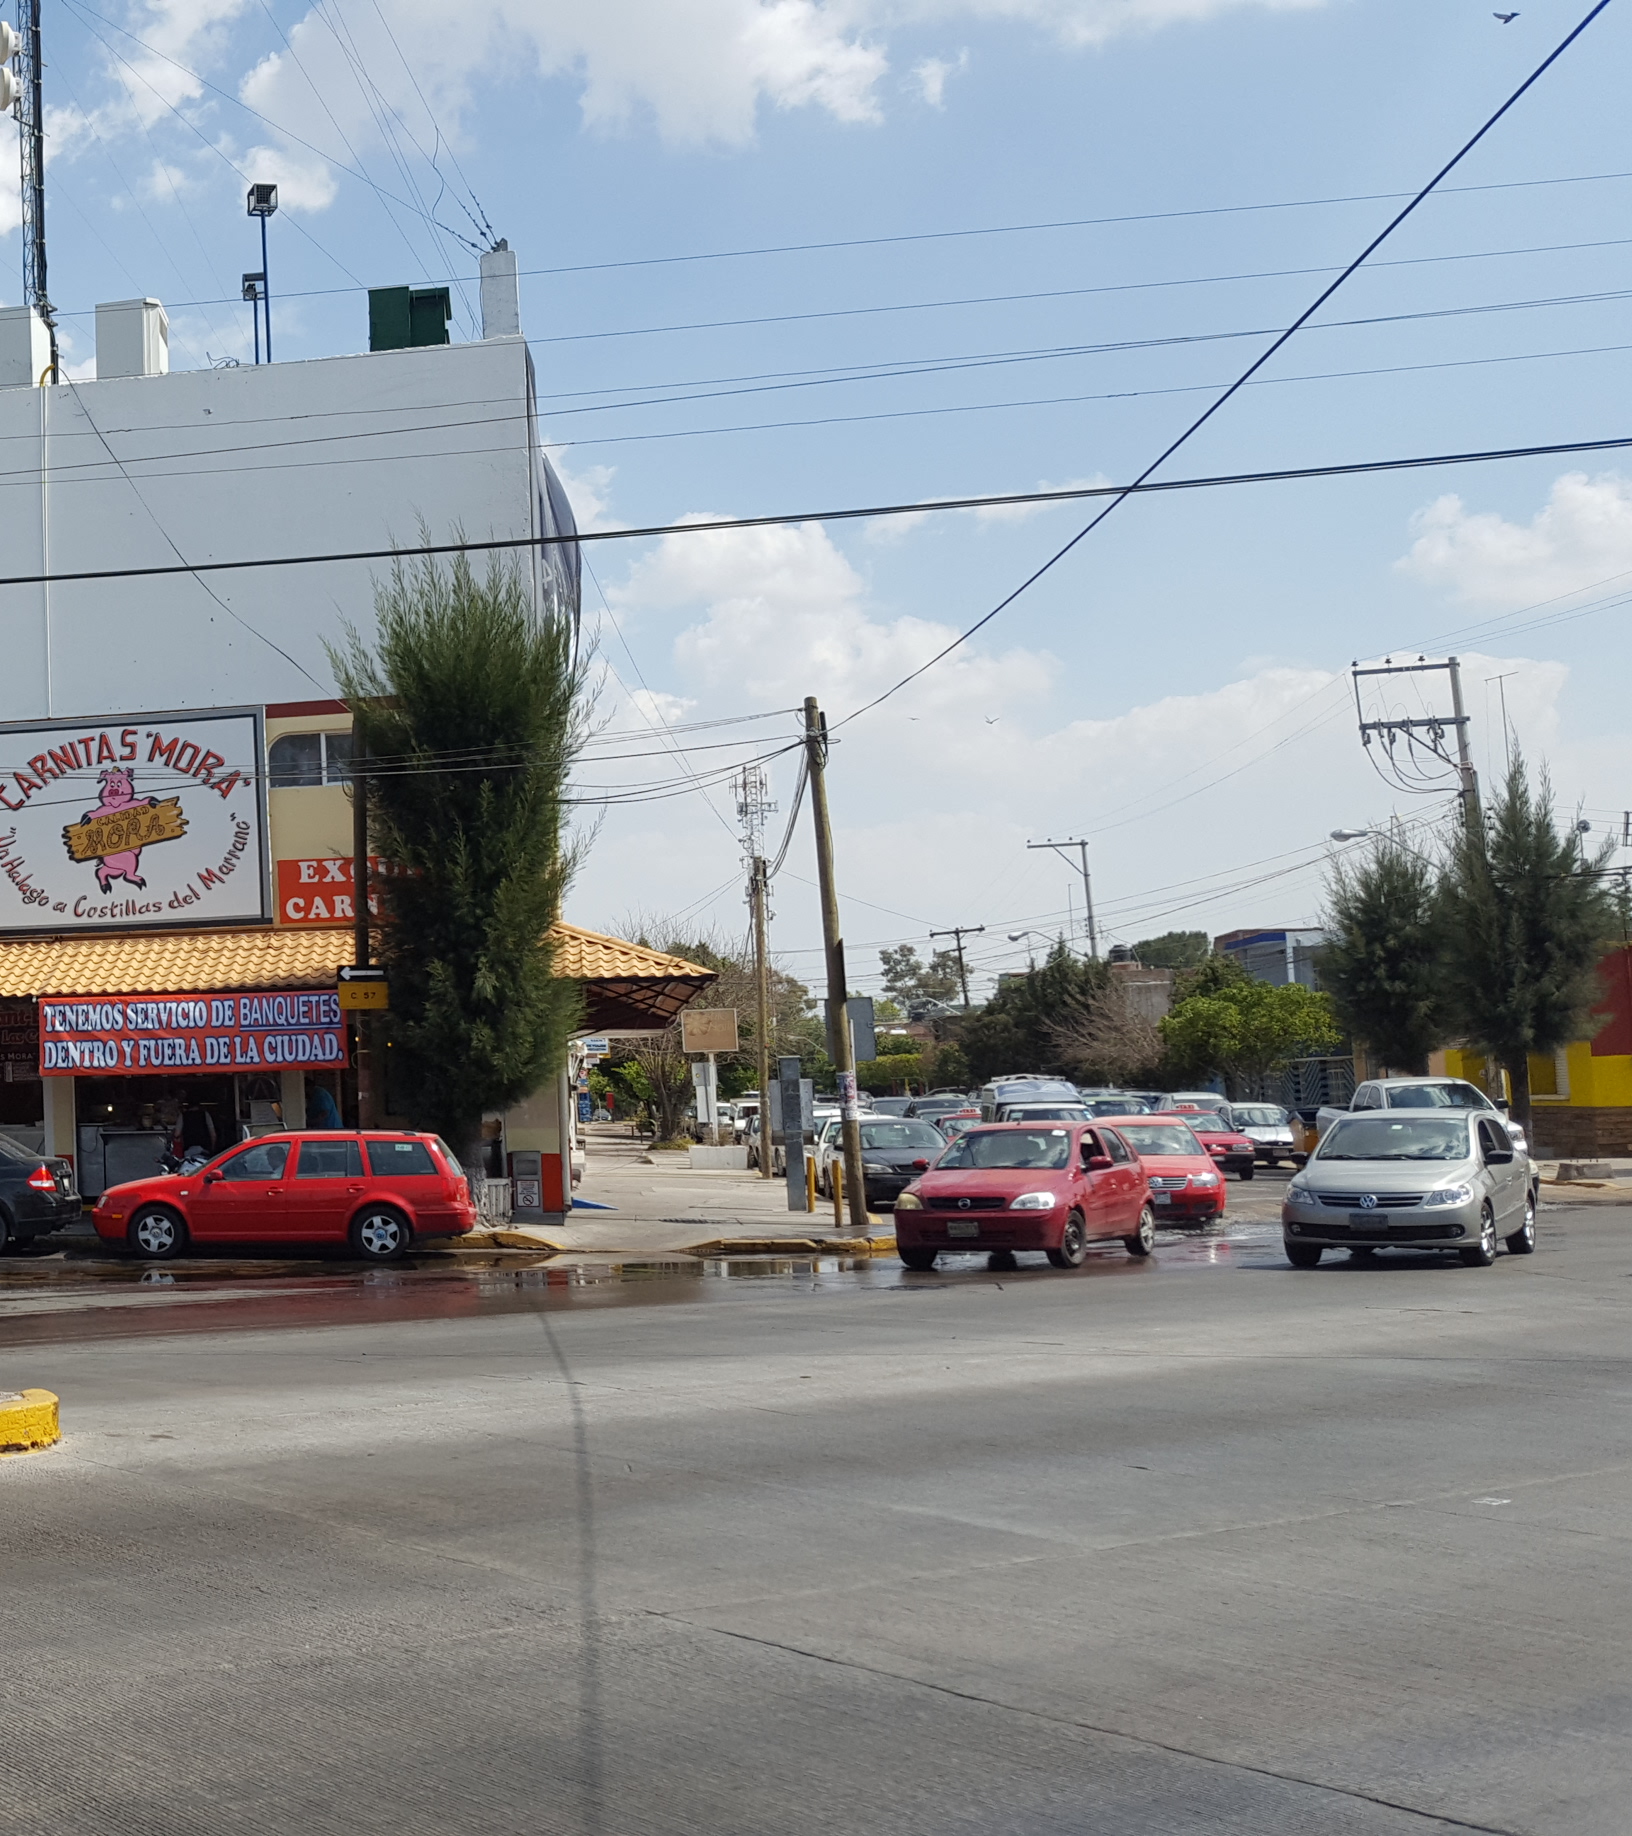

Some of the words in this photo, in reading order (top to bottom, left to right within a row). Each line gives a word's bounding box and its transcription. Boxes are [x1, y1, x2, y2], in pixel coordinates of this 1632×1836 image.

[81, 814, 166, 855] MORA
[96, 806, 149, 827] CALIDAD
[1, 856, 49, 906] Halago
[53, 902, 67, 913] a
[74, 895, 162, 917] Costillas
[169, 884, 200, 910] del
[43, 1003, 124, 1032] TENEMOS
[126, 1000, 208, 1030] SERVICIO
[210, 998, 236, 1028] DE
[239, 993, 341, 1027] BANQUETES
[43, 1039, 119, 1069] DENTRO
[120, 1039, 135, 1068] Y
[137, 1036, 203, 1068] FUERA
[204, 1036, 232, 1065] DE
[233, 1034, 261, 1065] LA
[263, 1032, 344, 1064] CIUDAD.
